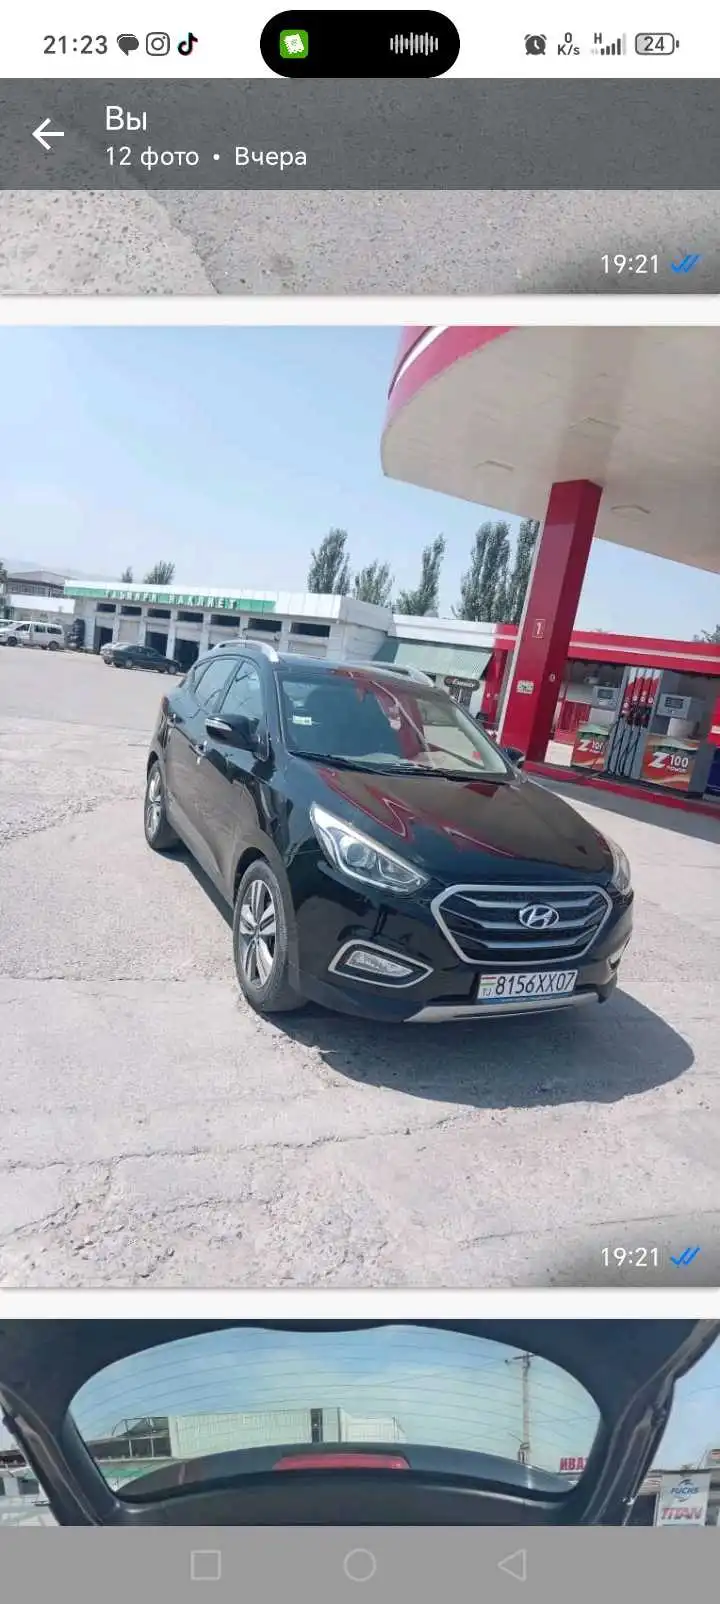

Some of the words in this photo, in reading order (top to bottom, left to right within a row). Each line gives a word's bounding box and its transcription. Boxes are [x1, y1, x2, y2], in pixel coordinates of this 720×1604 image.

[648, 752, 669, 768] Z
[670, 754, 689, 768] 100
[495, 972, 576, 995] 8156XX07
